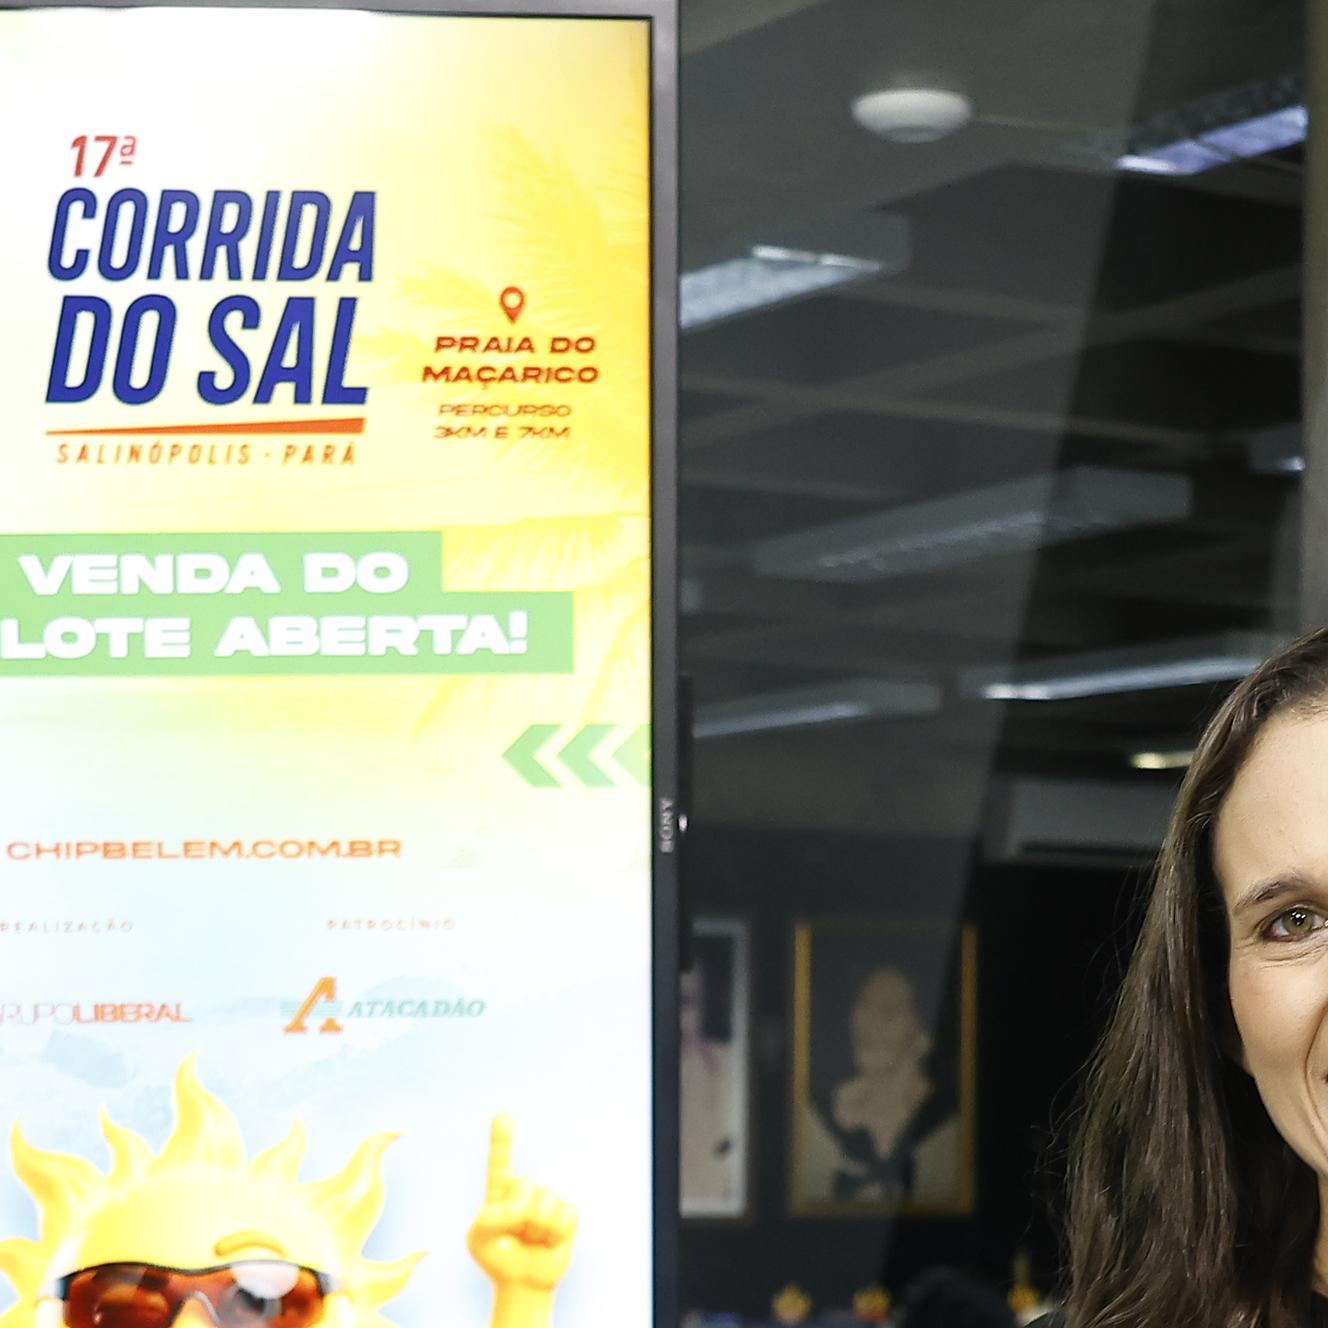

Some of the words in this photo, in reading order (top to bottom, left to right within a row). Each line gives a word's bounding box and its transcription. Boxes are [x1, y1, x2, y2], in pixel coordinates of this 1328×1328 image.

[47, 187, 377, 282] CORRIDA
[45, 293, 177, 405] DO
[197, 294, 369, 405] SAL
[435, 336, 535, 353] PRAIA
[550, 336, 595, 353] DO
[422, 366, 599, 390] MAÇARICO
[438, 404, 572, 416] PERCURSO
[494, 426, 509, 438] E
[56, 441, 251, 465] SALINÓPOLIS
[282, 440, 356, 465] PARÁ
[18, 552, 281, 597] VENDA
[303, 552, 409, 595] DO
[0, 615, 192, 660] LOTE
[214, 611, 529, 658] ABERTA!
[6, 840, 402, 860] CHIPBELEM.COM.BR
